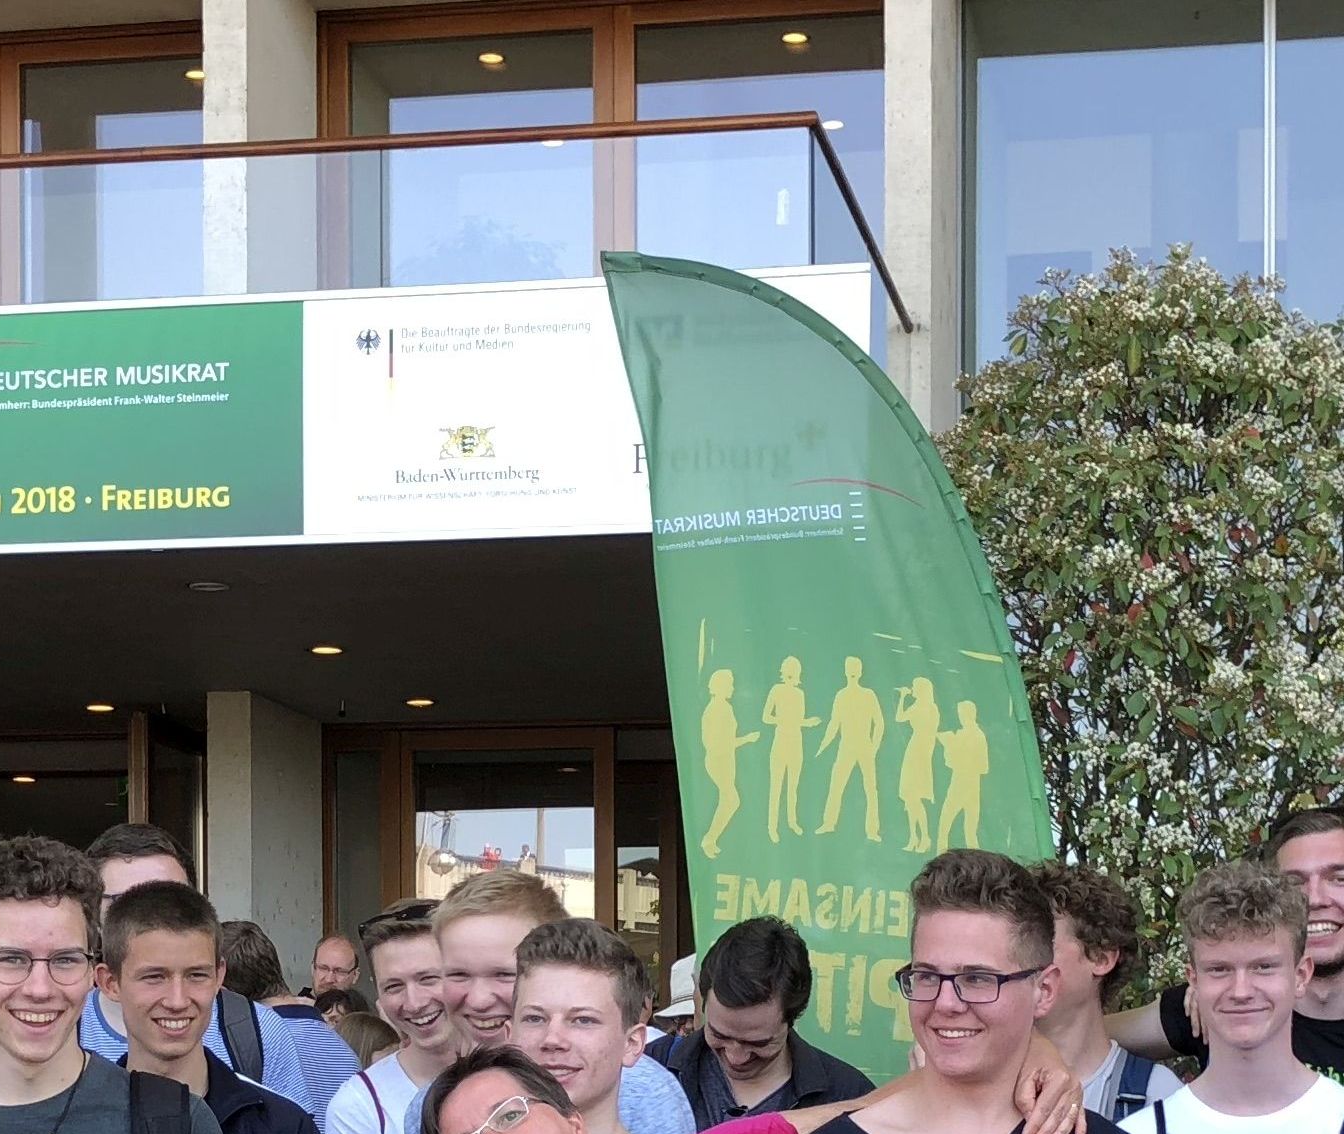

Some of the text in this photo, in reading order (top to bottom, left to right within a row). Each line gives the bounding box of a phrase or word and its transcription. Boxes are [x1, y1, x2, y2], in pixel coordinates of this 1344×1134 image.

[116, 361, 230, 387] MUSIKRAT
[176, 391, 230, 404] Steinmeier
[11, 486, 77, 515] 2018
